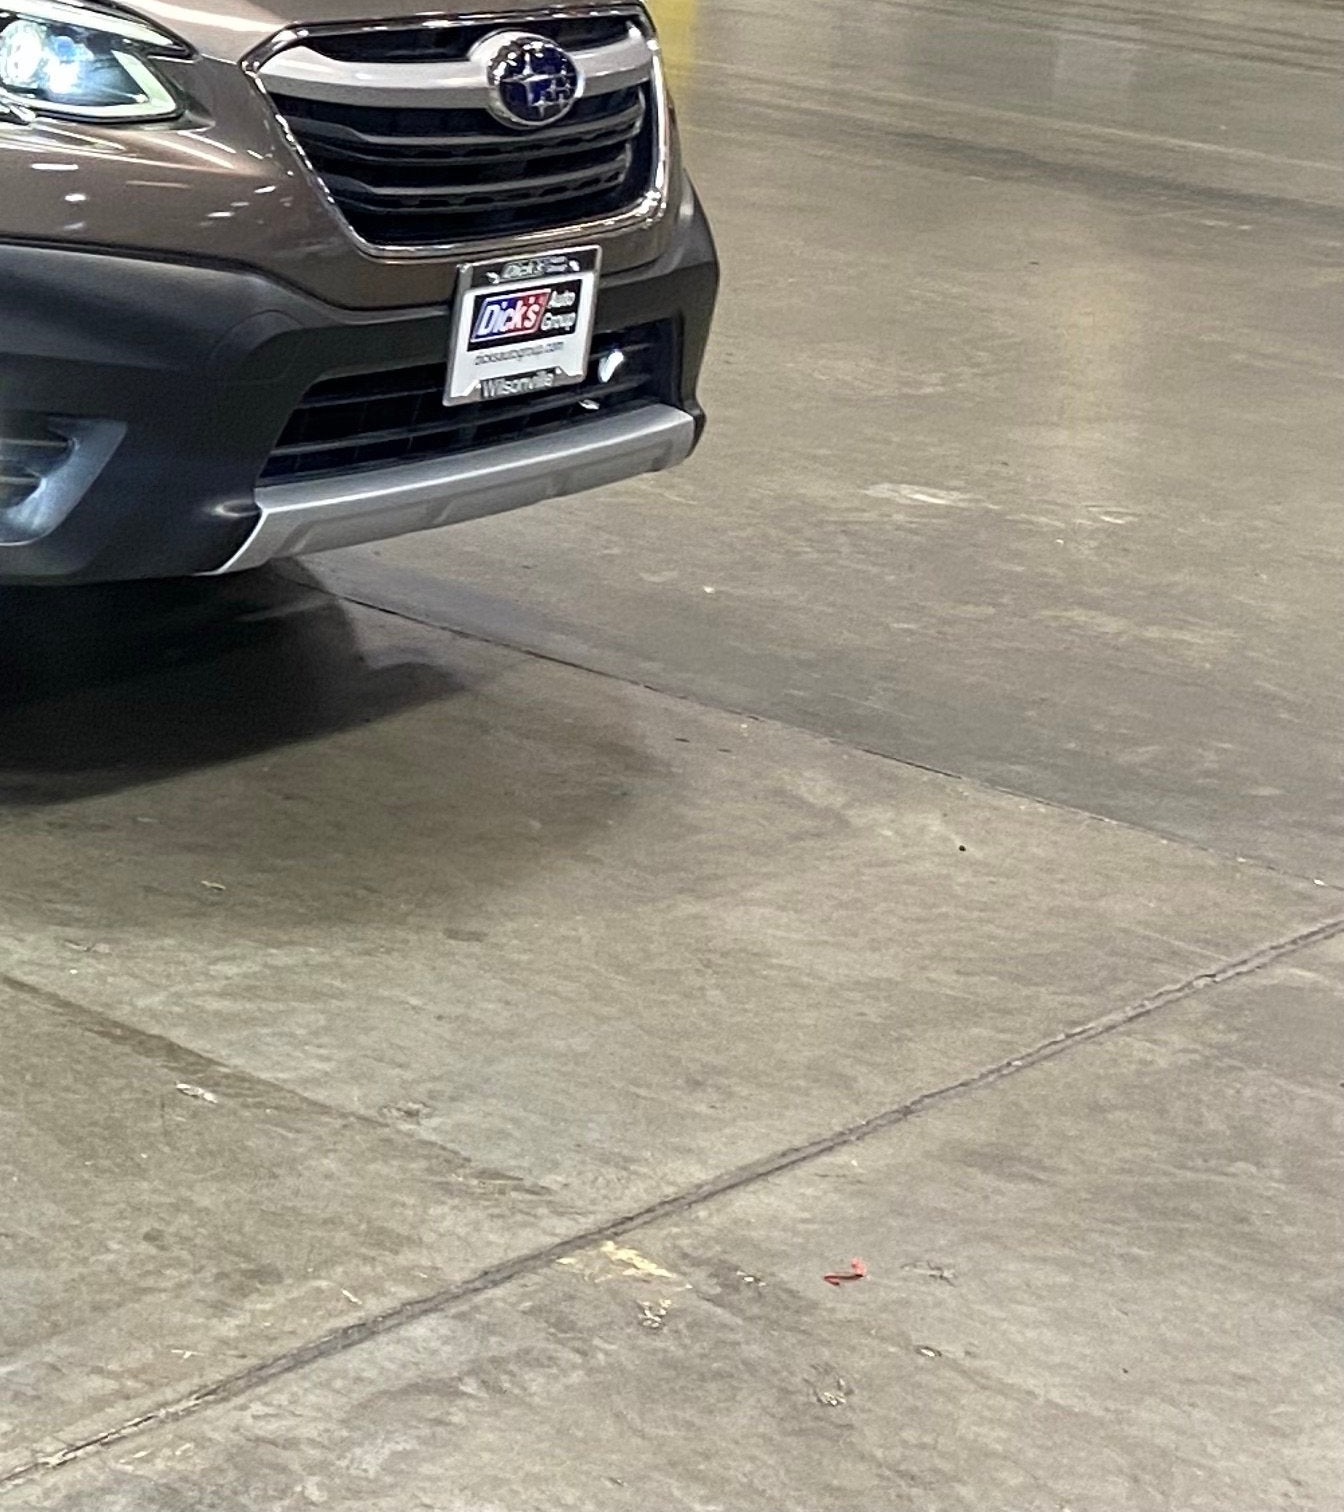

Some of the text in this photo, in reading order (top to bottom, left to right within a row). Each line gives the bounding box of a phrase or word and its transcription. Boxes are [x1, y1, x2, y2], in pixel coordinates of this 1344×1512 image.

[547, 288, 576, 309] Auto
[477, 296, 541, 337] Dick's
[480, 370, 555, 398] Wilsonville
